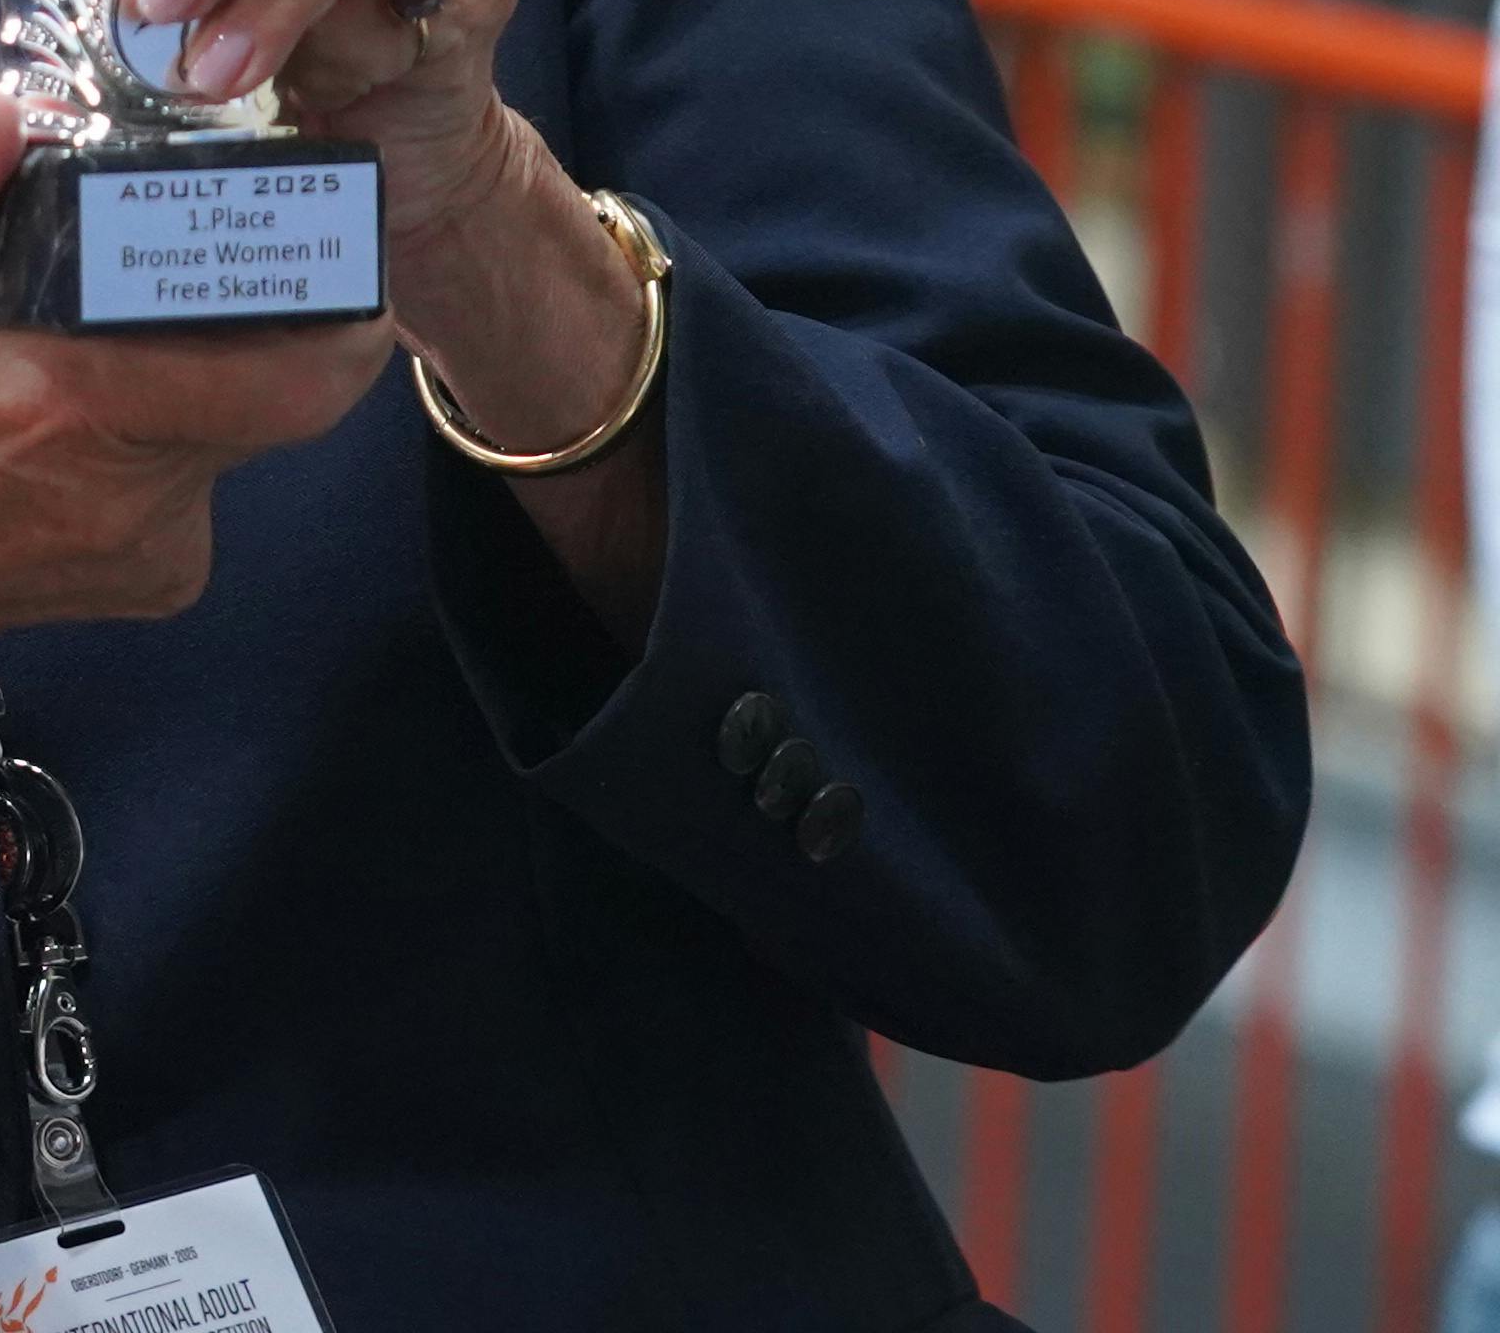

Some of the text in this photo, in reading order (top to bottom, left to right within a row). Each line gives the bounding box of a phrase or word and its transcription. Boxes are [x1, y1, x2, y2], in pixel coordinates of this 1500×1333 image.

[120, 174, 340, 200] ADULT 2025
[188, 206, 276, 231] 1.Place
[122, 236, 340, 268] Bronze Women III
[156, 273, 308, 302] Free Skating
[71, 1266, 124, 1293] OBERSTDORF
[129, 1252, 171, 1276] GERMANY
[174, 1245, 198, 1264] 2025
[198, 1279, 256, 1323] ADULT
